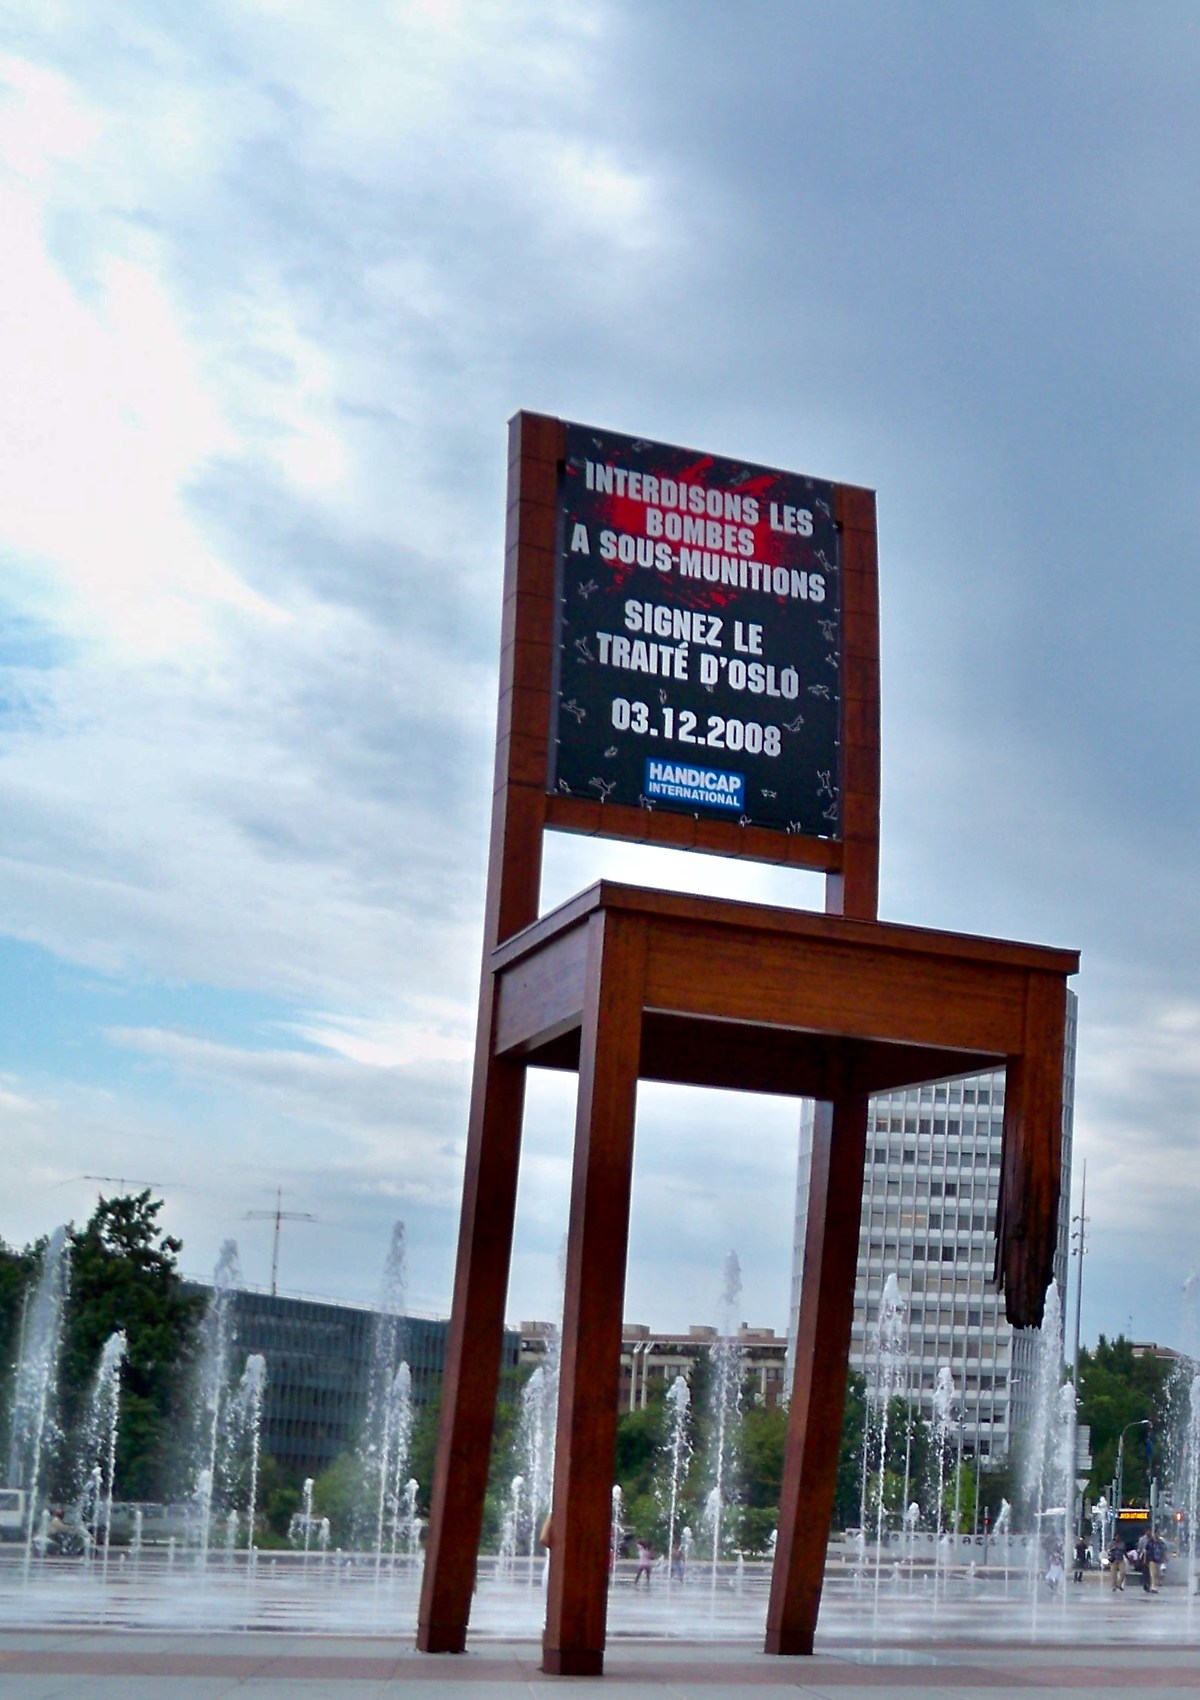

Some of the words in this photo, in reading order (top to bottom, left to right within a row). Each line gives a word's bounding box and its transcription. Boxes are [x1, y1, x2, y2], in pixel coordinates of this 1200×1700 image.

[585, 461, 760, 526] INTERDISONS
[769, 502, 814, 538] LES
[646, 507, 755, 556] BOMBES
[570, 523, 590, 554] A
[599, 530, 826, 603] SOUS-MUNITIONS
[624, 599, 724, 648] SIGNEZ
[734, 621, 763, 655] LE
[596, 631, 689, 681] TRAITÉ
[700, 653, 799, 700] D'OSLO
[611, 697, 781, 757] 03.12.2008
[649, 762, 741, 793] HANDICAP
[649, 782, 740, 807] INTERNATIONAL
